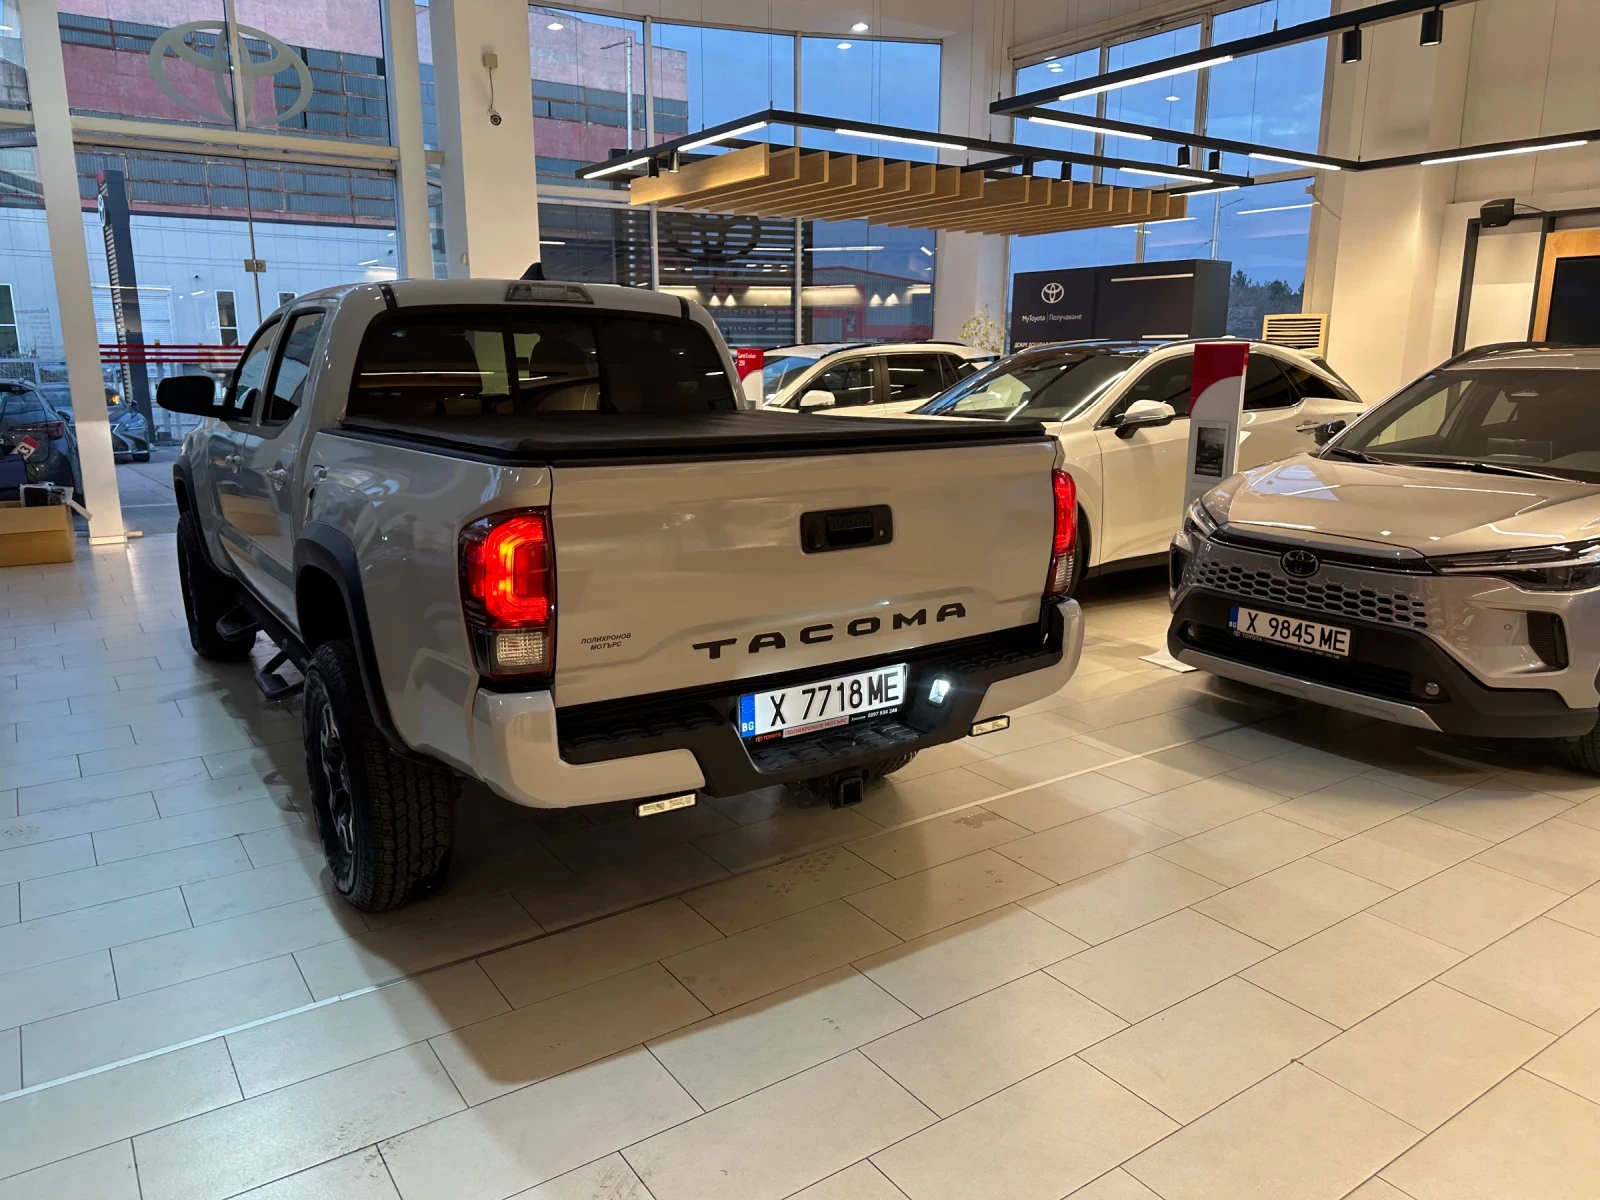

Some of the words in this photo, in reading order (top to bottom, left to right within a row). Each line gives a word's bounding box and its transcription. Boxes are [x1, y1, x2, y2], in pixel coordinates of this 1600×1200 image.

[1021, 314, 1046, 324] MyToyota
[1228, 621, 1237, 629] BG
[692, 602, 966, 660] TACOMA
[1268, 617, 1315, 645] 9845
[581, 632, 632, 645] ПОЛИХРОНОВ
[590, 640, 622, 651] МОТЪРС
[802, 679, 863, 721] 7718
[742, 721, 755, 732] BG
[763, 732, 782, 740] TOYOTA
